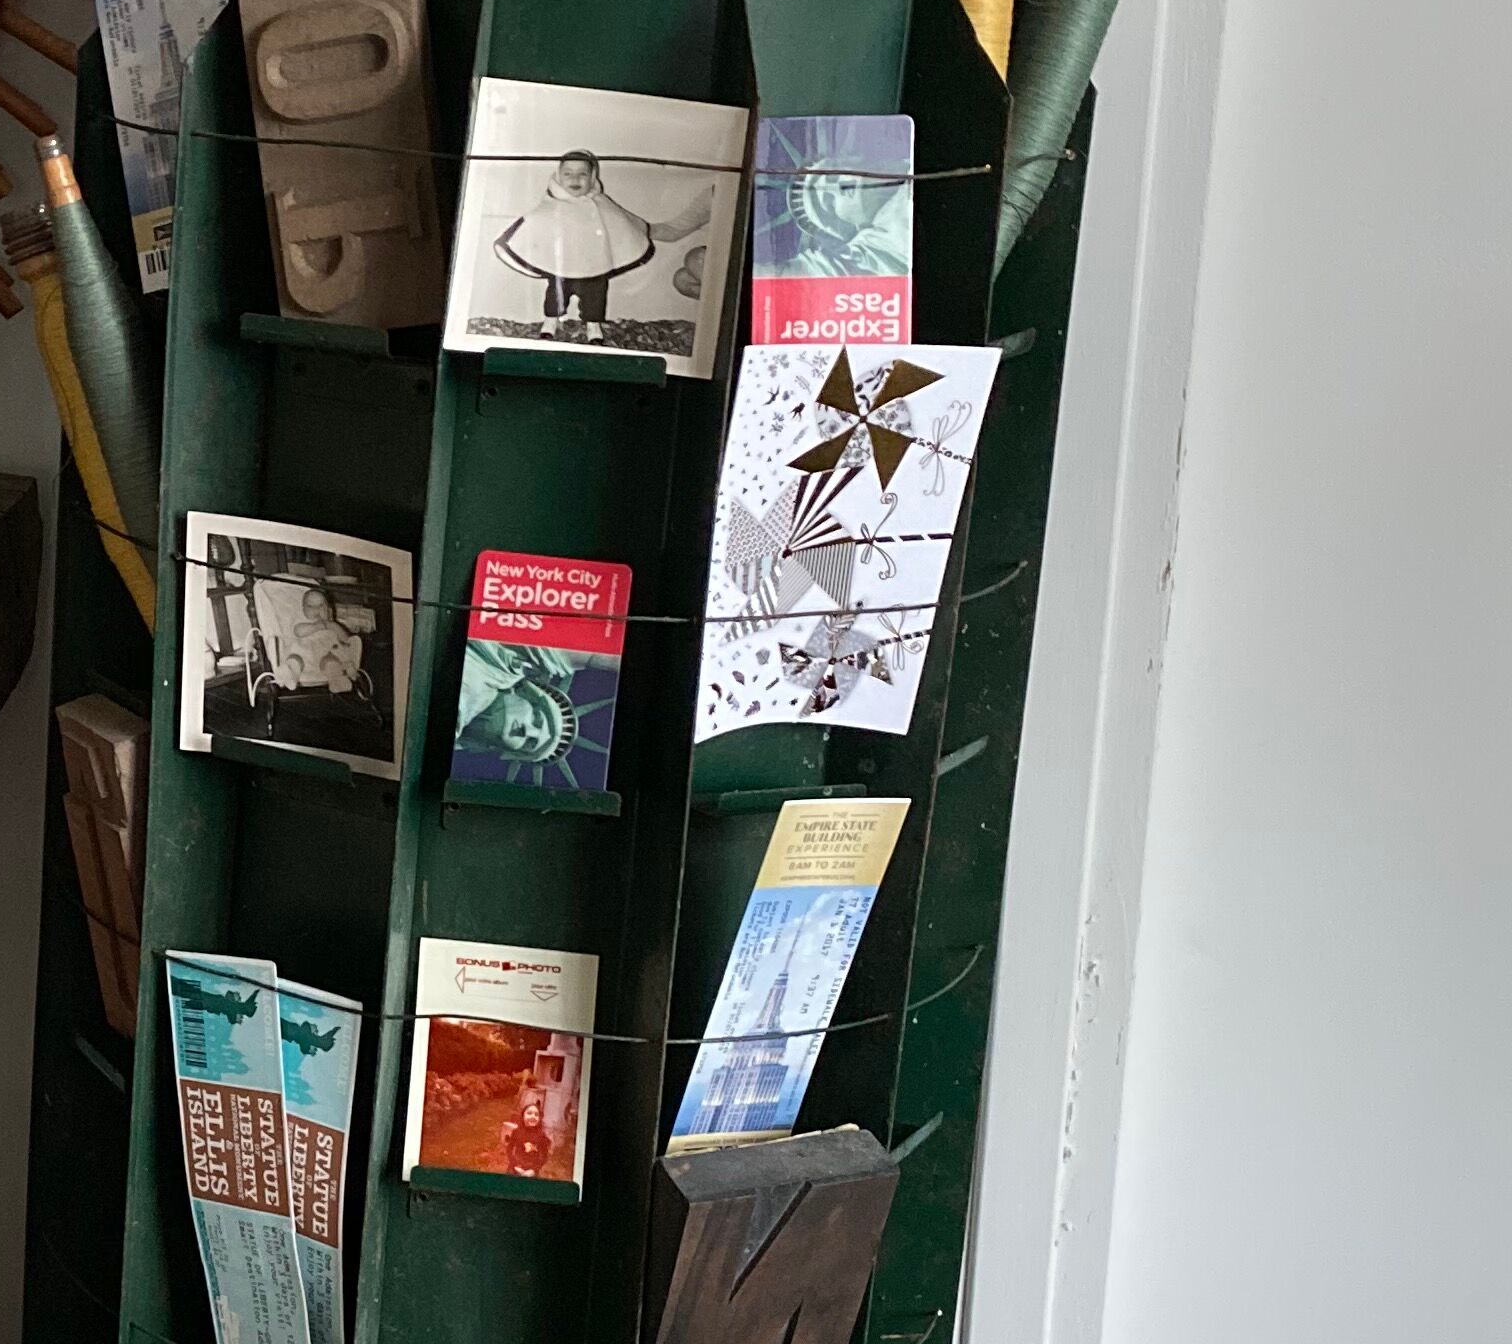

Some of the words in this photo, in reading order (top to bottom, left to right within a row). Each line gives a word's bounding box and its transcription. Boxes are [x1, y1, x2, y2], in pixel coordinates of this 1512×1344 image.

[835, 293, 900, 317] Pass
[780, 314, 900, 343] Explorer
[486, 559, 524, 578] New
[526, 564, 564, 583] York
[567, 569, 602, 589] City
[483, 577, 600, 610] Explorer
[479, 601, 543, 631] Pass
[794, 821, 841, 832] EMPIRE
[841, 820, 878, 831] STATE
[803, 832, 863, 843] BUILDING
[786, 843, 870, 854] EXPERIENCE
[815, 861, 829, 870] TO
[847, 920, 863, 948] VALID
[456, 957, 500, 968] BONUS
[517, 962, 562, 974] PHOTO
[839, 953, 851, 971] FOR
[186, 1086, 210, 1192] ISLAND
[202, 1089, 230, 1196] ELLIS
[237, 1094, 258, 1203] LIBERTY
[257, 1098, 280, 1207] STATUE
[292, 1123, 309, 1230] LIBERTY
[312, 1131, 334, 1238] STATUE
